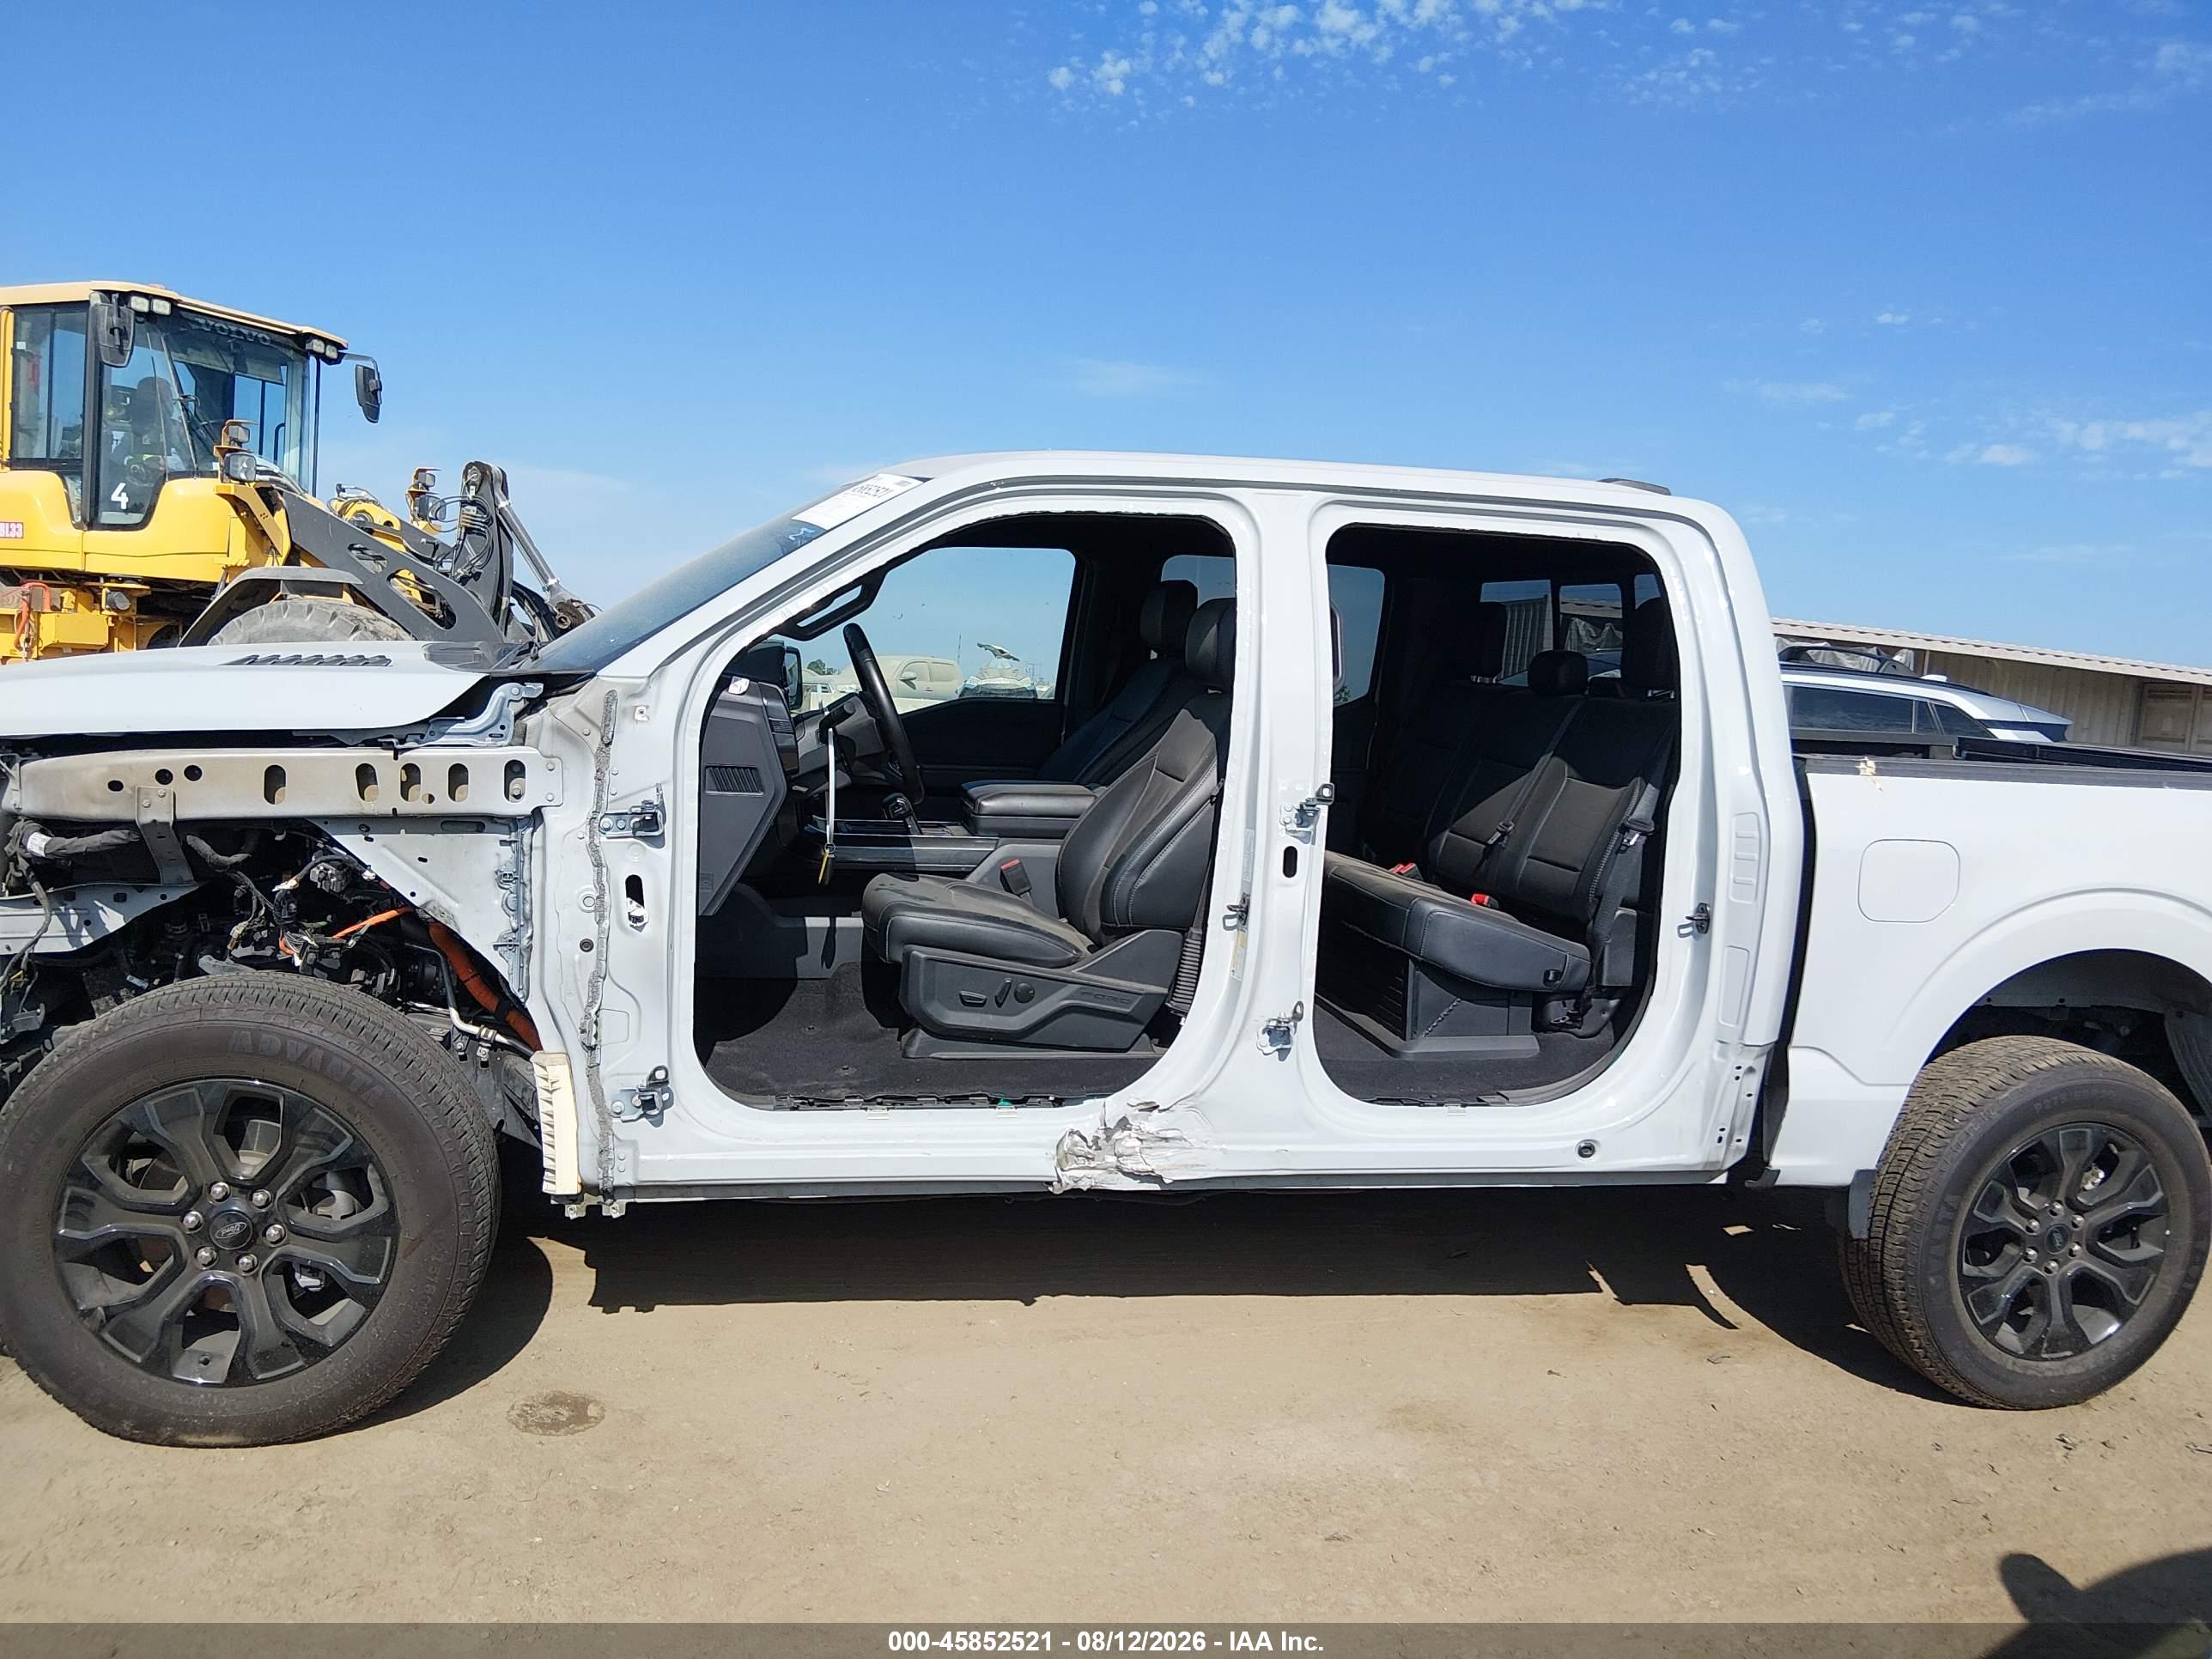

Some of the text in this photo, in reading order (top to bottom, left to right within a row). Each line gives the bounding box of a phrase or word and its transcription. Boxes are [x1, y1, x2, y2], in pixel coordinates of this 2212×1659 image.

[195, 317, 271, 346] VOLVO
[111, 482, 129, 510] 4
[231, 1030, 386, 1109] ADVANTA
